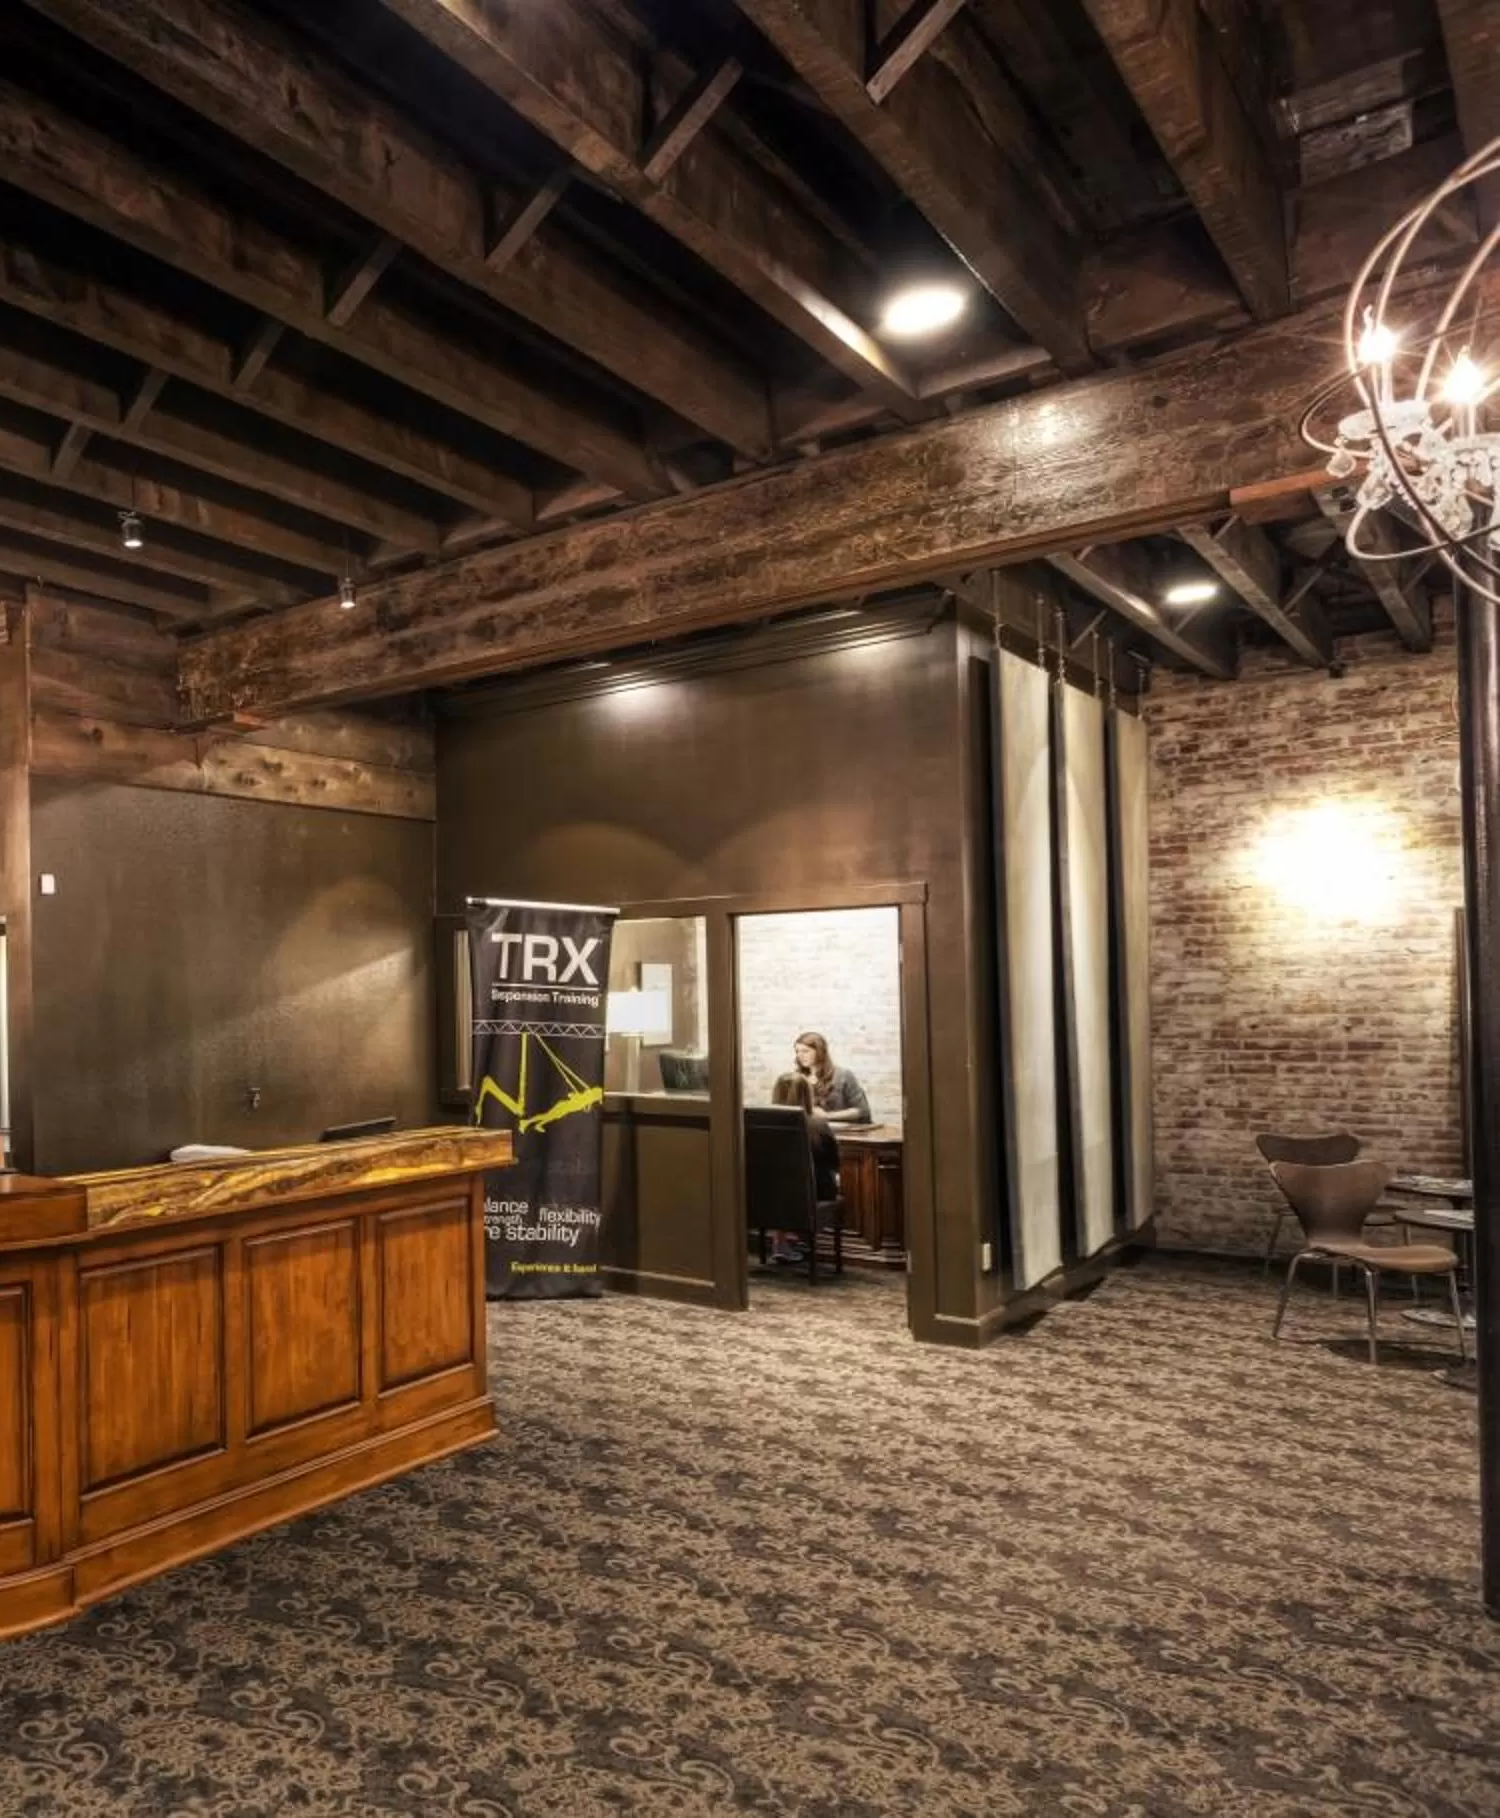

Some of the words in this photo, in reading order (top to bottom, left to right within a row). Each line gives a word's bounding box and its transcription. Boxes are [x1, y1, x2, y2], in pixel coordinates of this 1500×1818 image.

[491, 932, 600, 985] TRX
[552, 991, 599, 1008] Training
[539, 1207, 602, 1231] flexibility
[505, 1222, 580, 1248] stability
